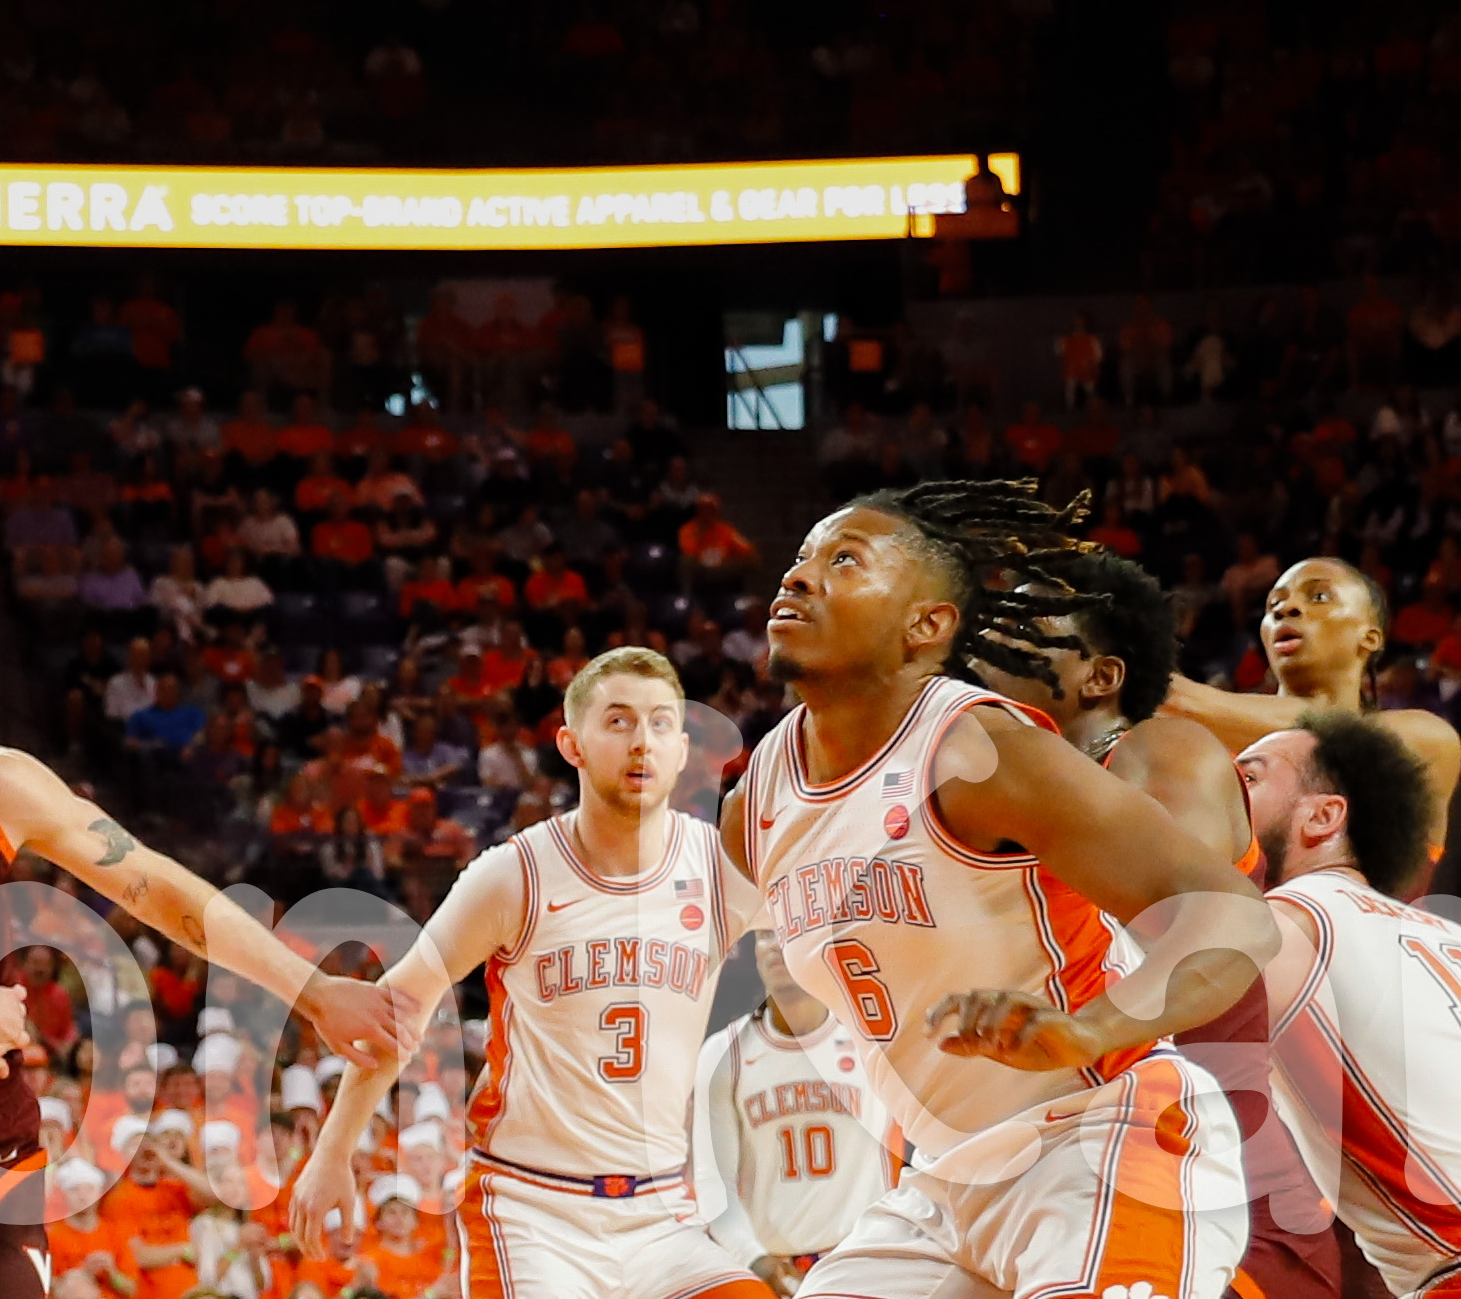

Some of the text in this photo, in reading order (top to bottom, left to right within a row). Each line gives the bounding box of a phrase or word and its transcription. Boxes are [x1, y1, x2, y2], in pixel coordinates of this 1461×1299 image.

[466, 194, 570, 230] ACTIVE
[575, 191, 706, 227] APPAREL
[710, 193, 732, 222] &
[534, 937, 711, 1002] CLEMSON
[822, 939, 898, 1042] 6
[598, 1002, 649, 1082] 3
[741, 1080, 862, 1130] CLEMSON
[780, 1125, 837, 1180] 10
